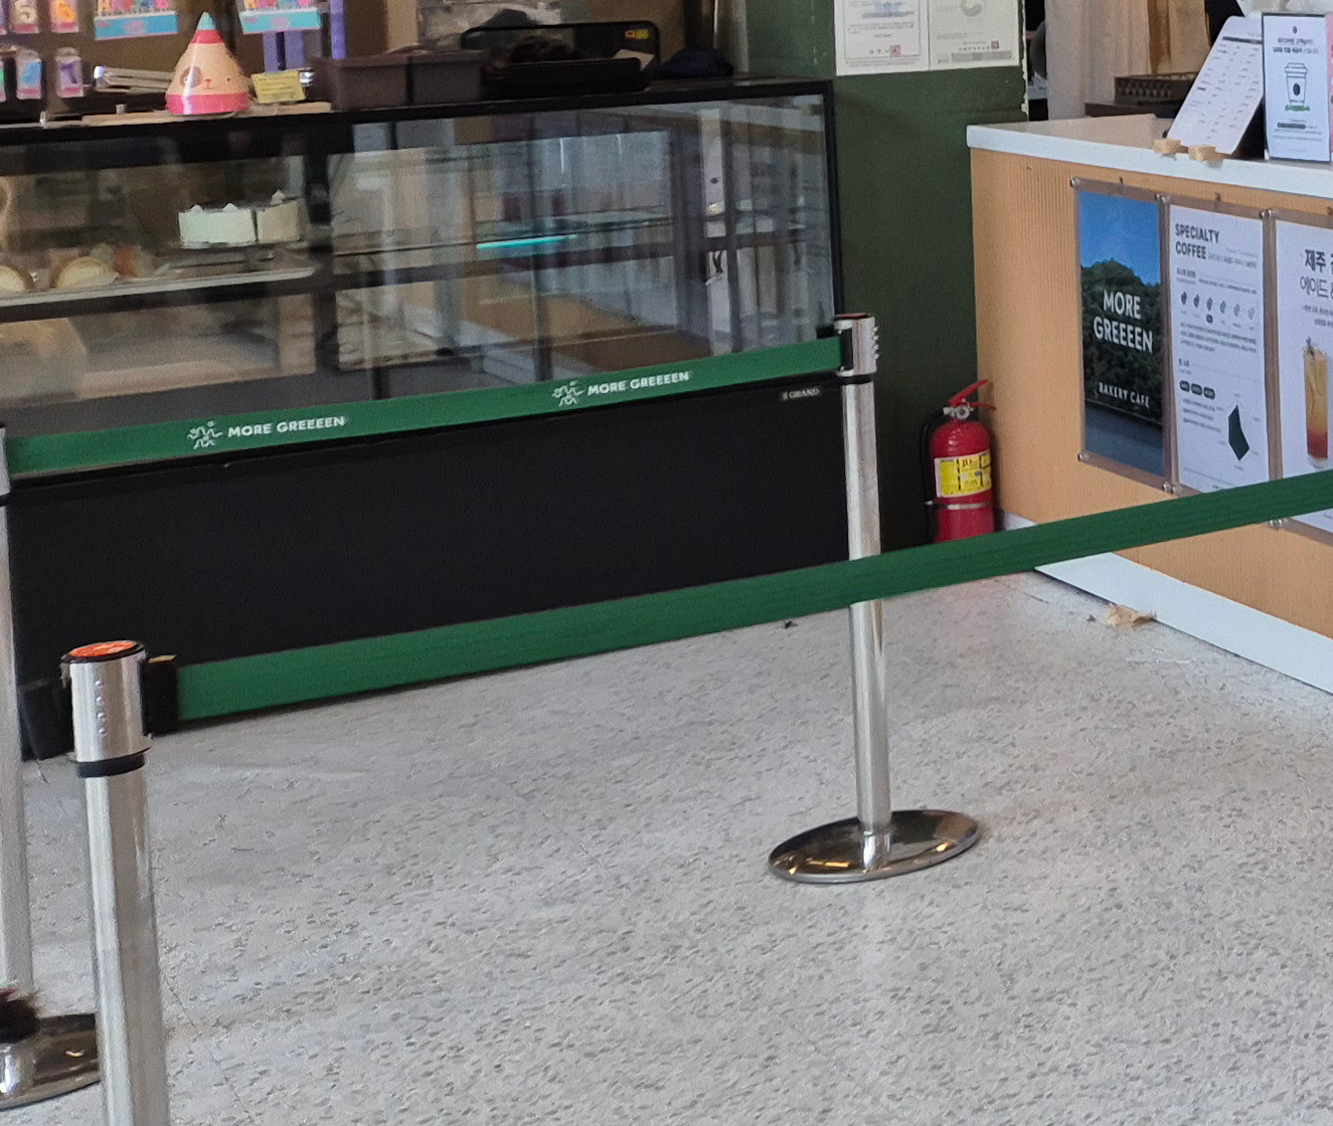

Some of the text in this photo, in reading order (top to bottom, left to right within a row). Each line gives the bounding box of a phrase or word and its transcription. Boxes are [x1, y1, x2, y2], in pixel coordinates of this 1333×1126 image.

[1175, 223, 1219, 243] SPECIALTY
[1176, 241, 1207, 259] COFFEE
[1305, 249, 1326, 272] 제주
[1300, 276, 1328, 298] 에이드
[1104, 290, 1141, 321] MORE
[1094, 313, 1152, 352] GREEEEN
[588, 372, 689, 395] MORE GREEEEN
[1099, 382, 1128, 402] BAKERY
[228, 416, 345, 437] MORE GREEEEN
